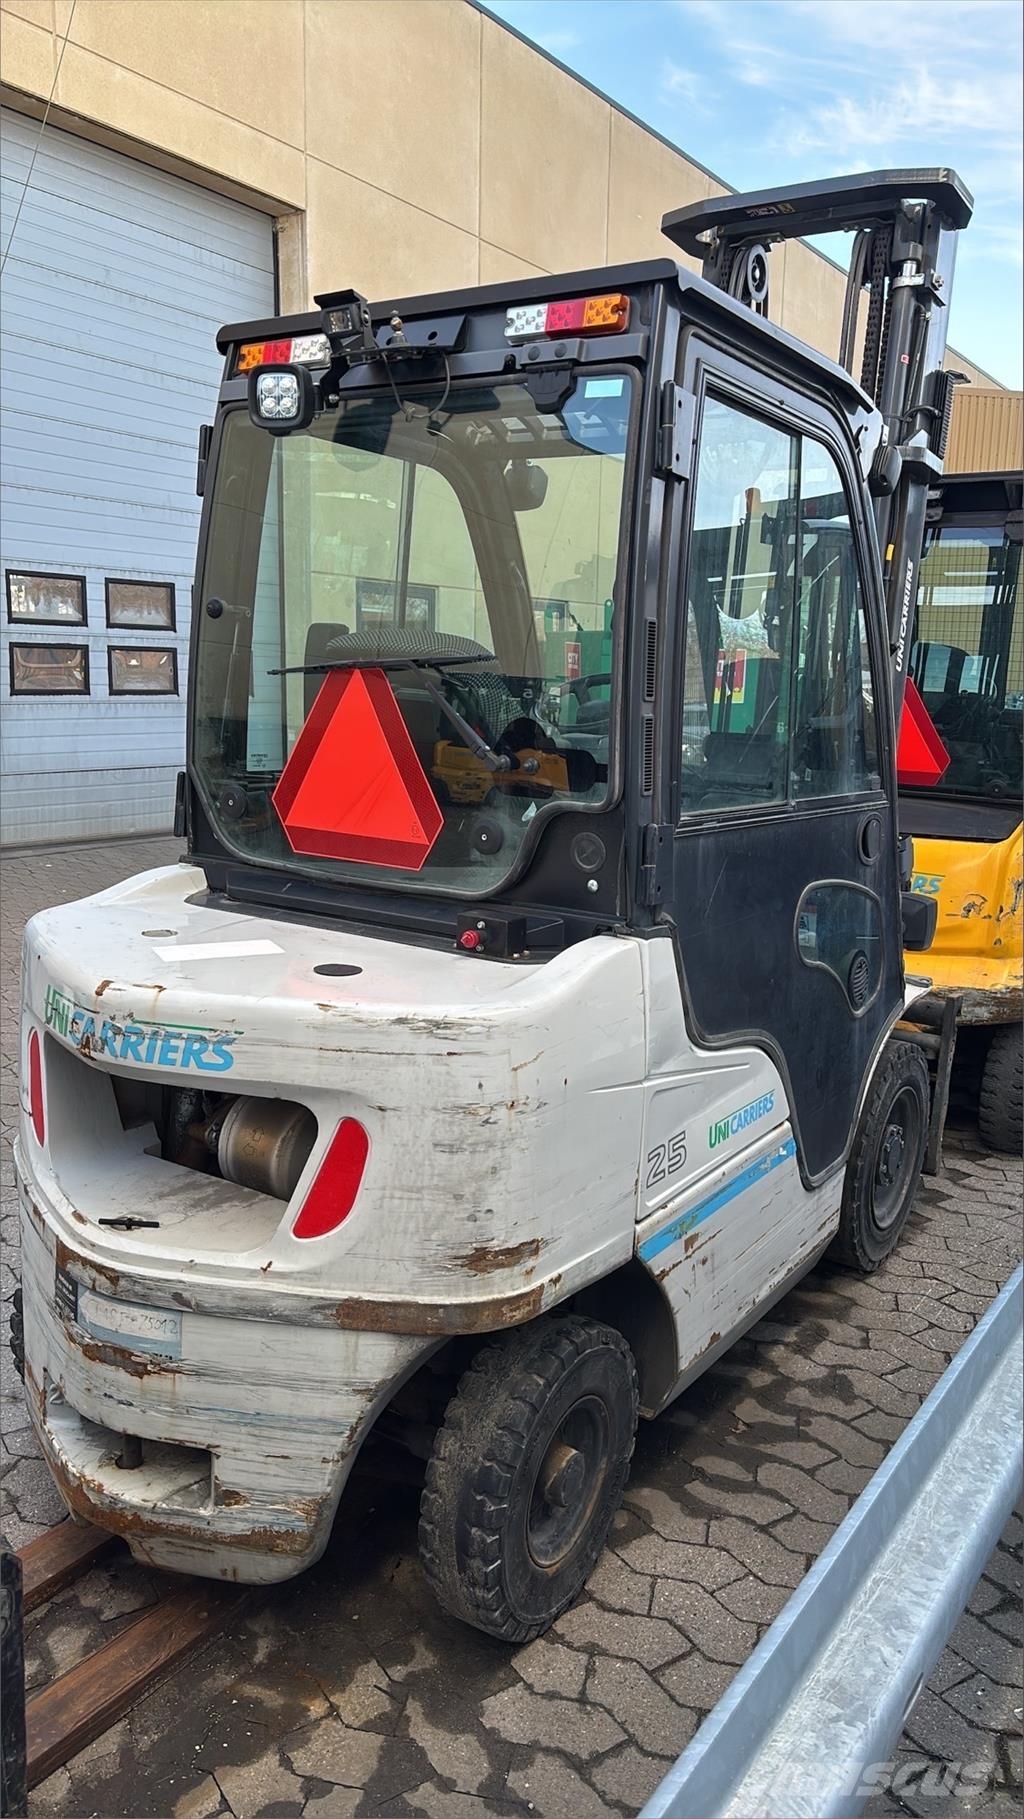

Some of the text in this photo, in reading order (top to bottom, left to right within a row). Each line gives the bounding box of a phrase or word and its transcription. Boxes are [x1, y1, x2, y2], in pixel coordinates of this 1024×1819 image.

[895, 556, 914, 673] UNICARRIERS
[44, 984, 238, 1073] UNICARRIERS
[708, 1089, 775, 1149] UNICARRIERS
[645, 1130, 688, 1190] 25
